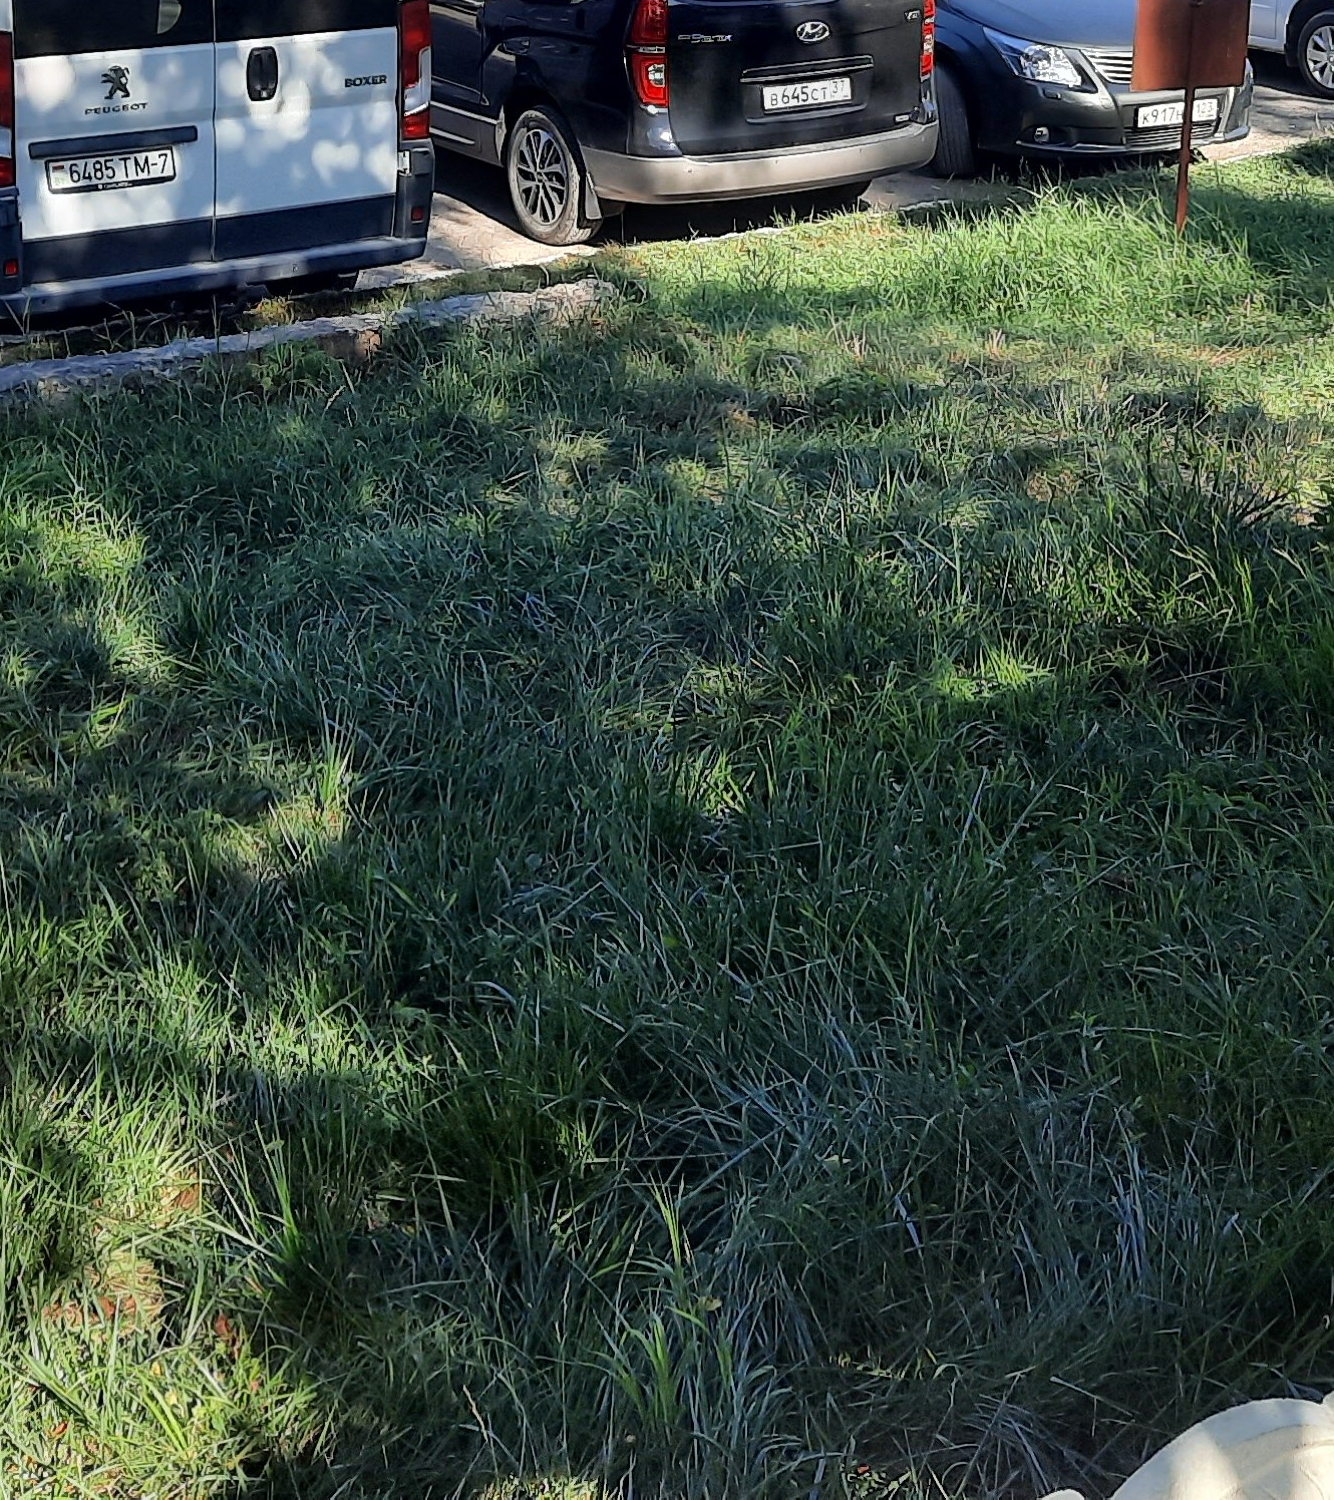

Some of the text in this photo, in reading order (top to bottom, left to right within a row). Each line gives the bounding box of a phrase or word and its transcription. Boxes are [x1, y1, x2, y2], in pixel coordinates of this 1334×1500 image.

[344, 74, 387, 88] BOXER
[770, 85, 829, 107] В645СТ
[84, 102, 149, 116] PEUGEOT
[68, 153, 169, 184] 6485 TM-7
